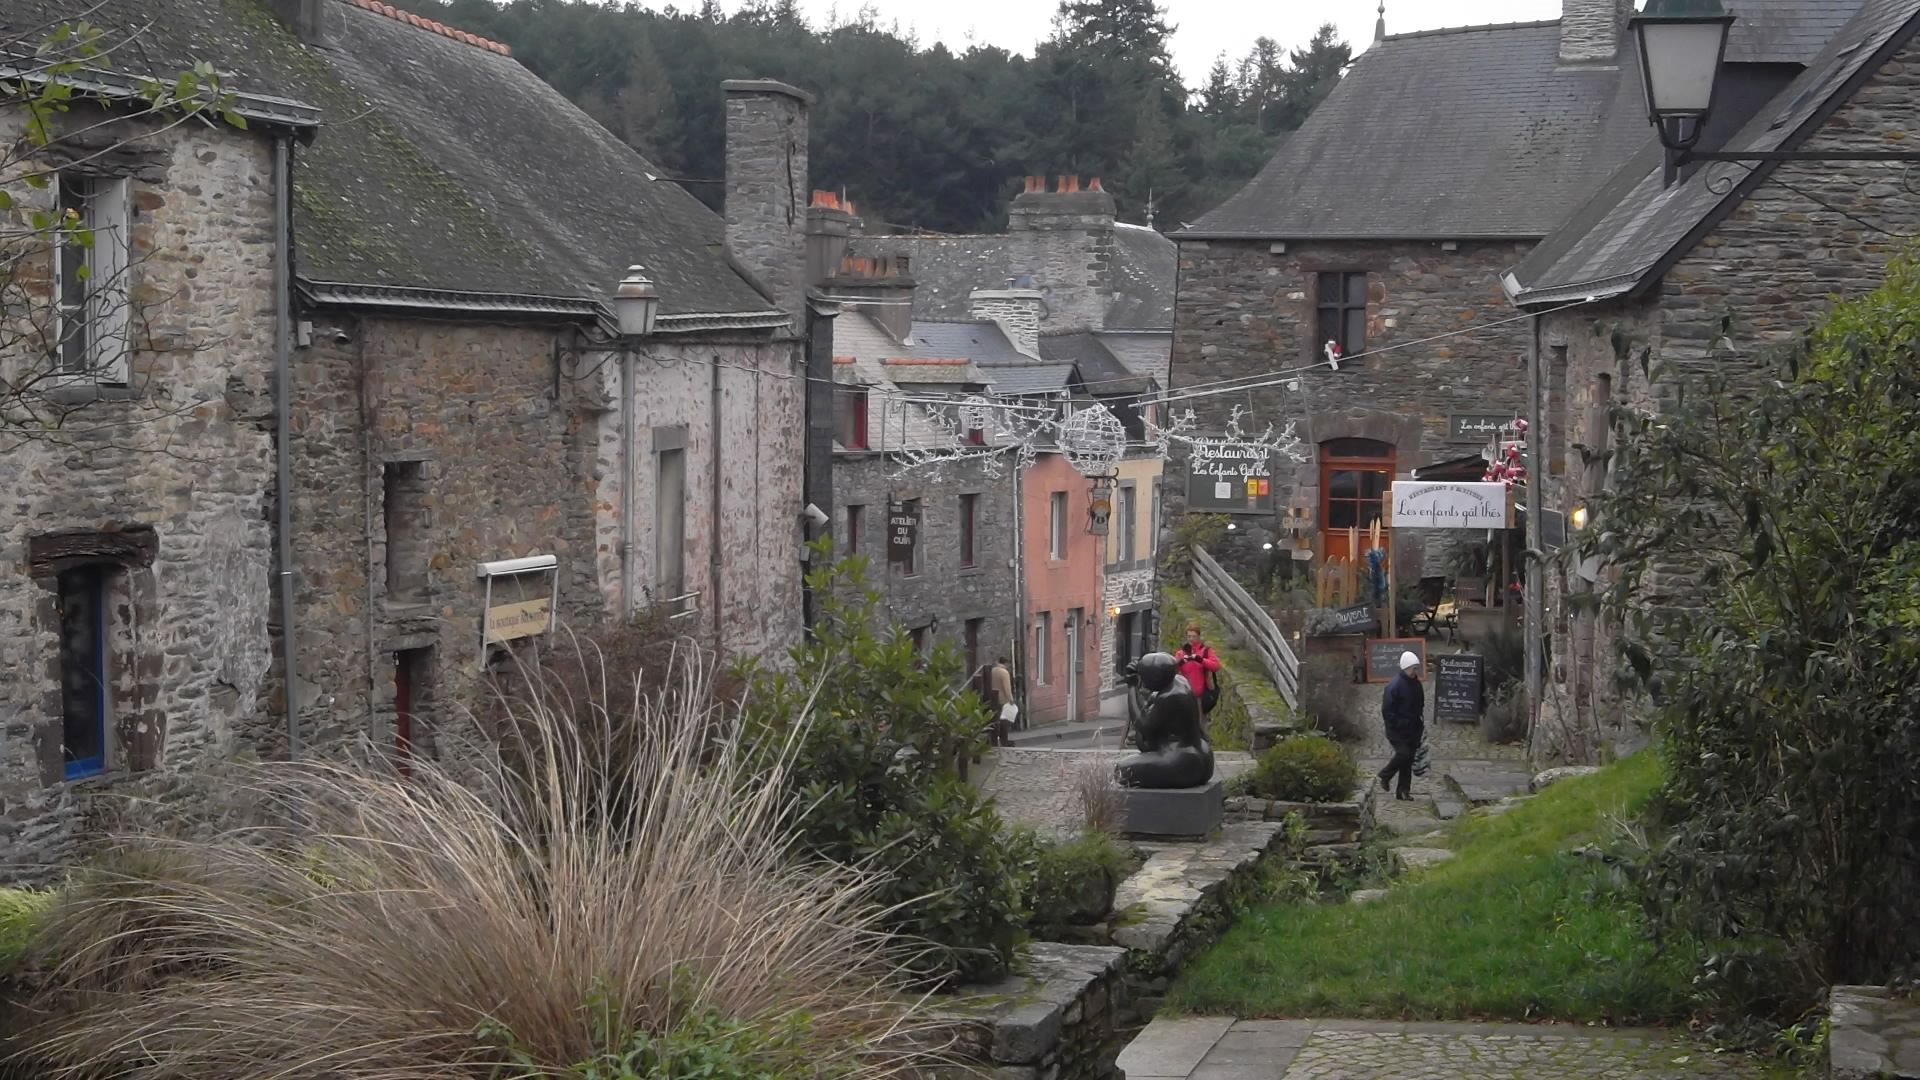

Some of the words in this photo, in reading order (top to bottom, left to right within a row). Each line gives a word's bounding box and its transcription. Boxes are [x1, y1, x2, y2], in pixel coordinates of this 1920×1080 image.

[1193, 444, 1270, 459] Restaurant
[1193, 462, 1208, 475] Les
[1209, 463, 1238, 481] Enfants
[1397, 500, 1416, 516] Les
[1420, 500, 1458, 526] enfants
[894, 536, 910, 544] CUIR
